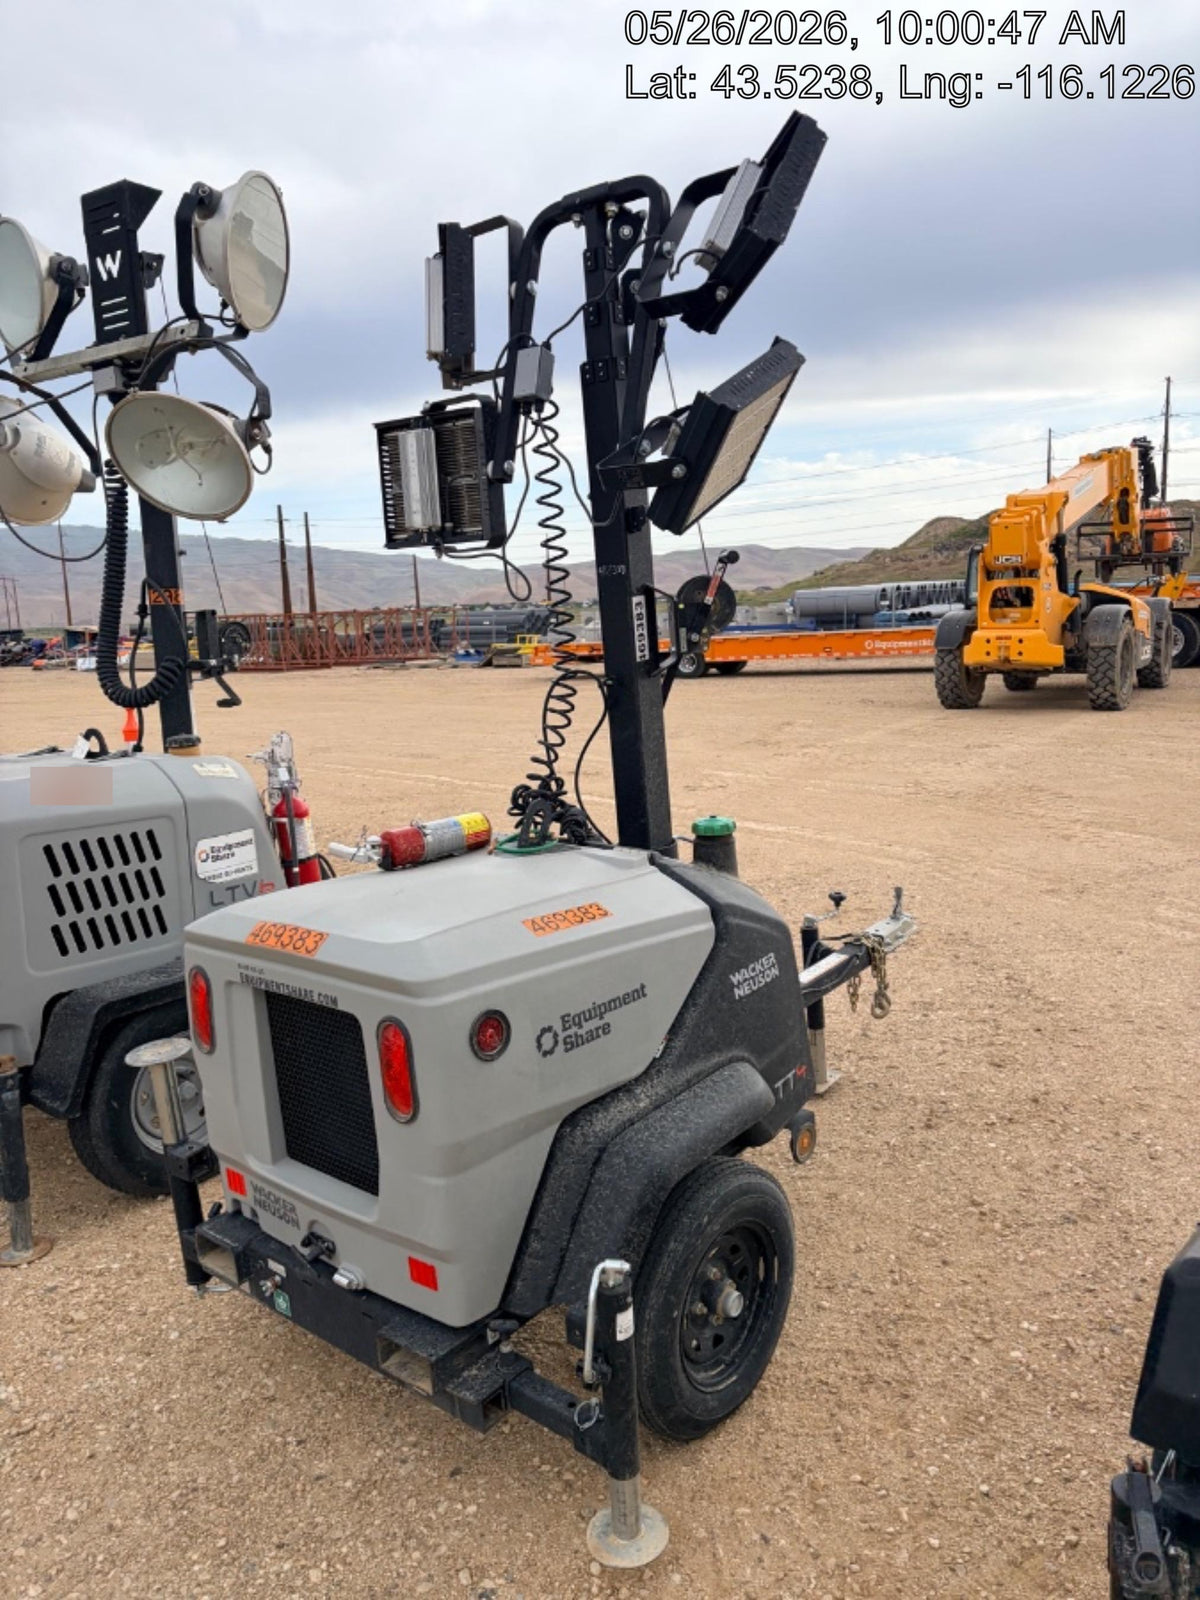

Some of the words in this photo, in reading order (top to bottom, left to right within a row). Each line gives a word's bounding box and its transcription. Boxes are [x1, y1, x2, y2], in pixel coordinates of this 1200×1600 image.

[96, 250, 122, 281] W
[530, 903, 609, 932] 469383
[251, 922, 324, 954] 469383
[729, 952, 776, 985] WACKER
[734, 964, 779, 999] NEUSON
[560, 983, 648, 1032] Equipment
[562, 1022, 612, 1053] Share
[250, 1181, 297, 1217] WACKER
[253, 1195, 301, 1231] NEUSON
